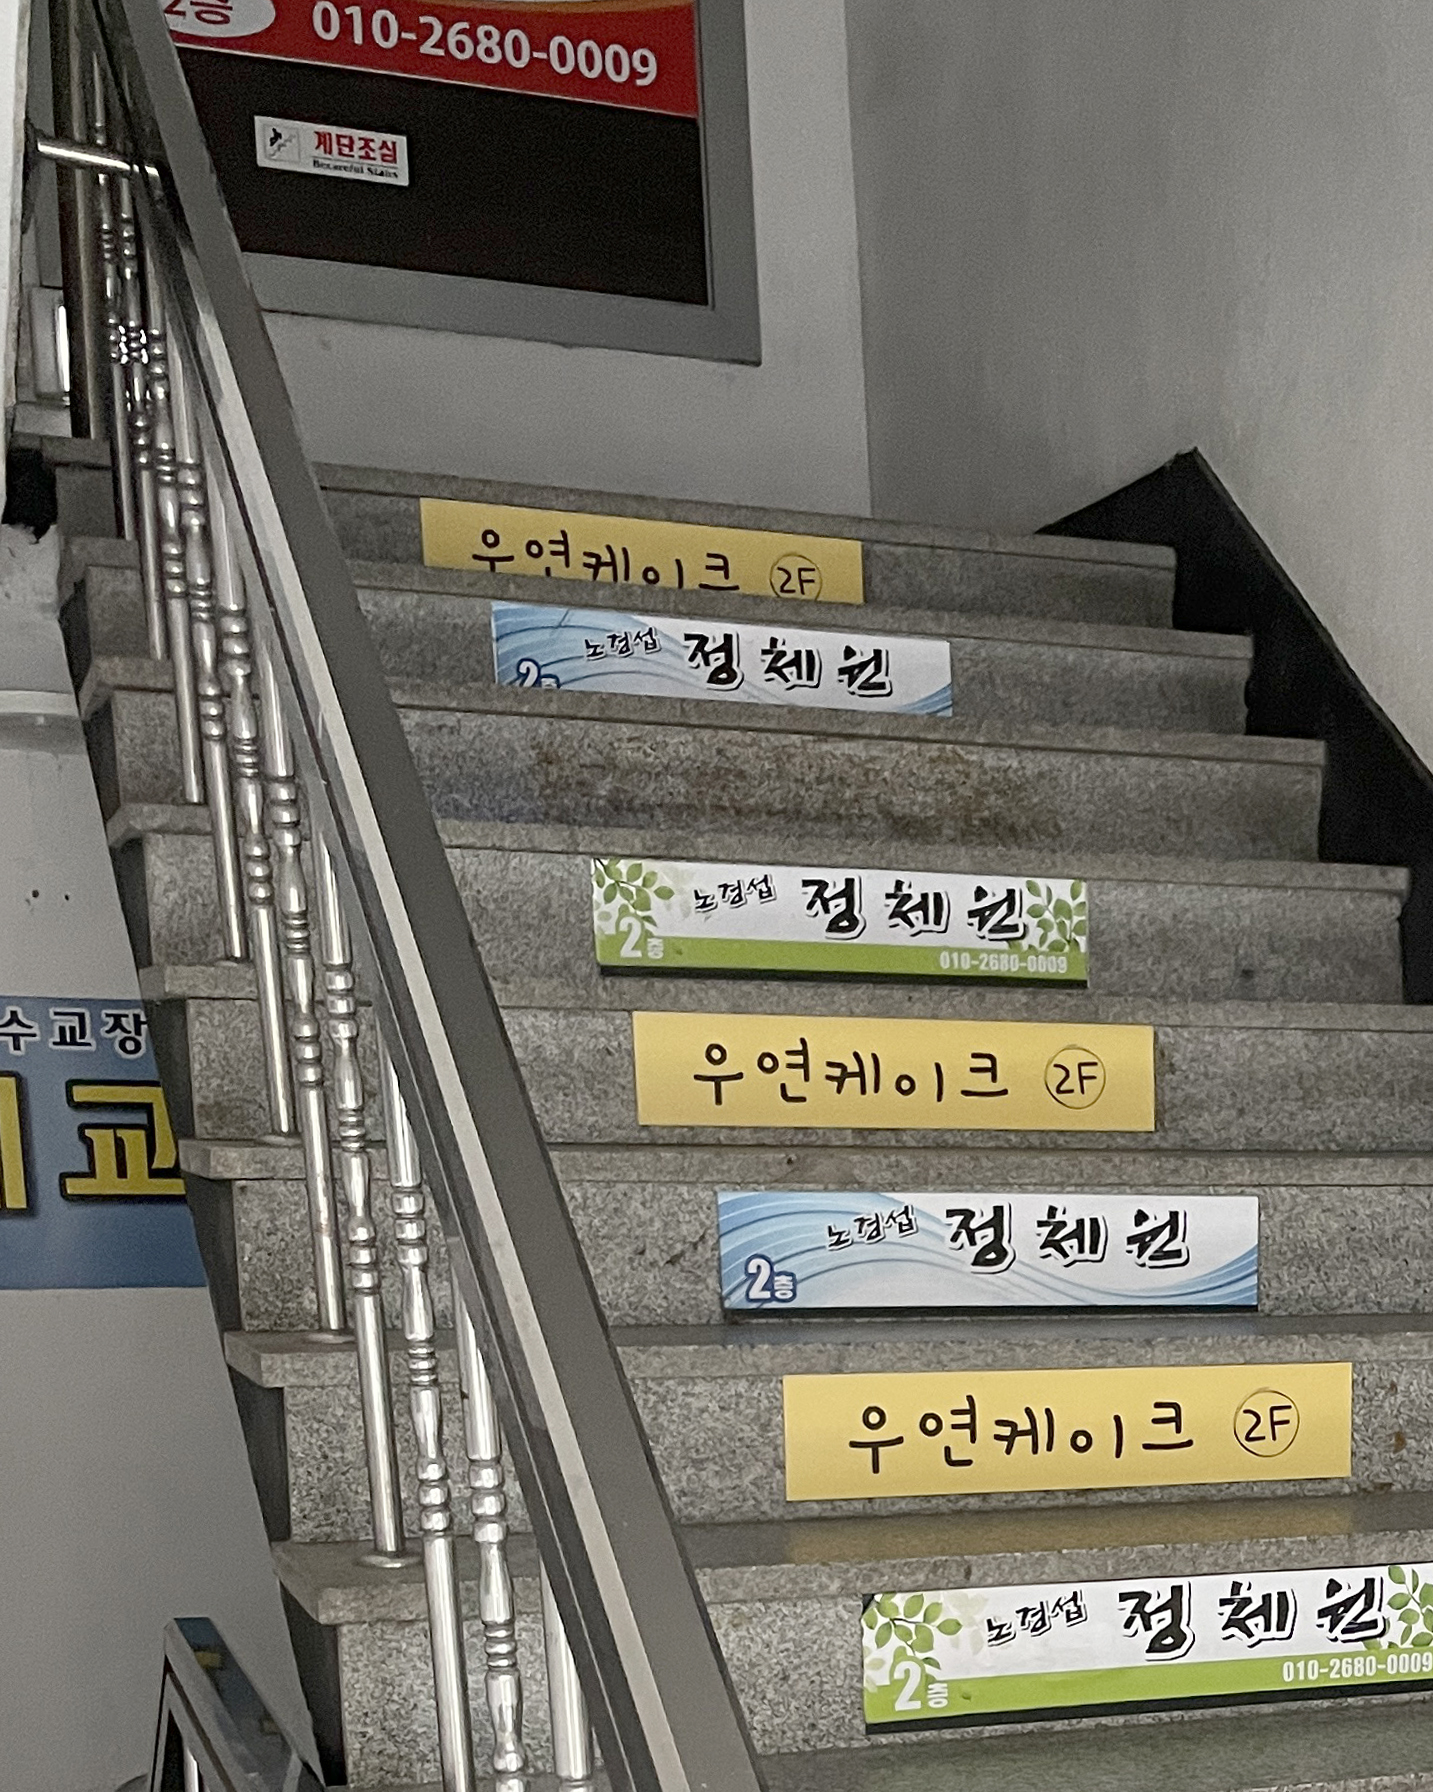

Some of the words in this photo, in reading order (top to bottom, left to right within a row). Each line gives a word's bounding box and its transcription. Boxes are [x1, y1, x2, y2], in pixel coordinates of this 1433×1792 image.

[312, 1, 658, 87] 010-2680-0009
[313, 130, 399, 165] 계단조심
[774, 561, 818, 598] 2F
[583, 625, 663, 661] 노경섭
[692, 872, 777, 914] 노경섭
[620, 915, 665, 960] 2층
[939, 950, 1069, 974] 010-2680-0009
[693, 1037, 1009, 1106] 우연케이크
[1050, 1056, 1101, 1099] 2F
[826, 1205, 917, 1250] 노경섭
[745, 1255, 797, 1302] 2층
[848, 1394, 1193, 1475] 우연케이크
[1239, 1399, 1296, 1448] 2F
[984, 1590, 1089, 1648] 노경섭
[892, 1659, 949, 1712] 2층
[1281, 1653, 1433, 1684] 010-2680-0009
